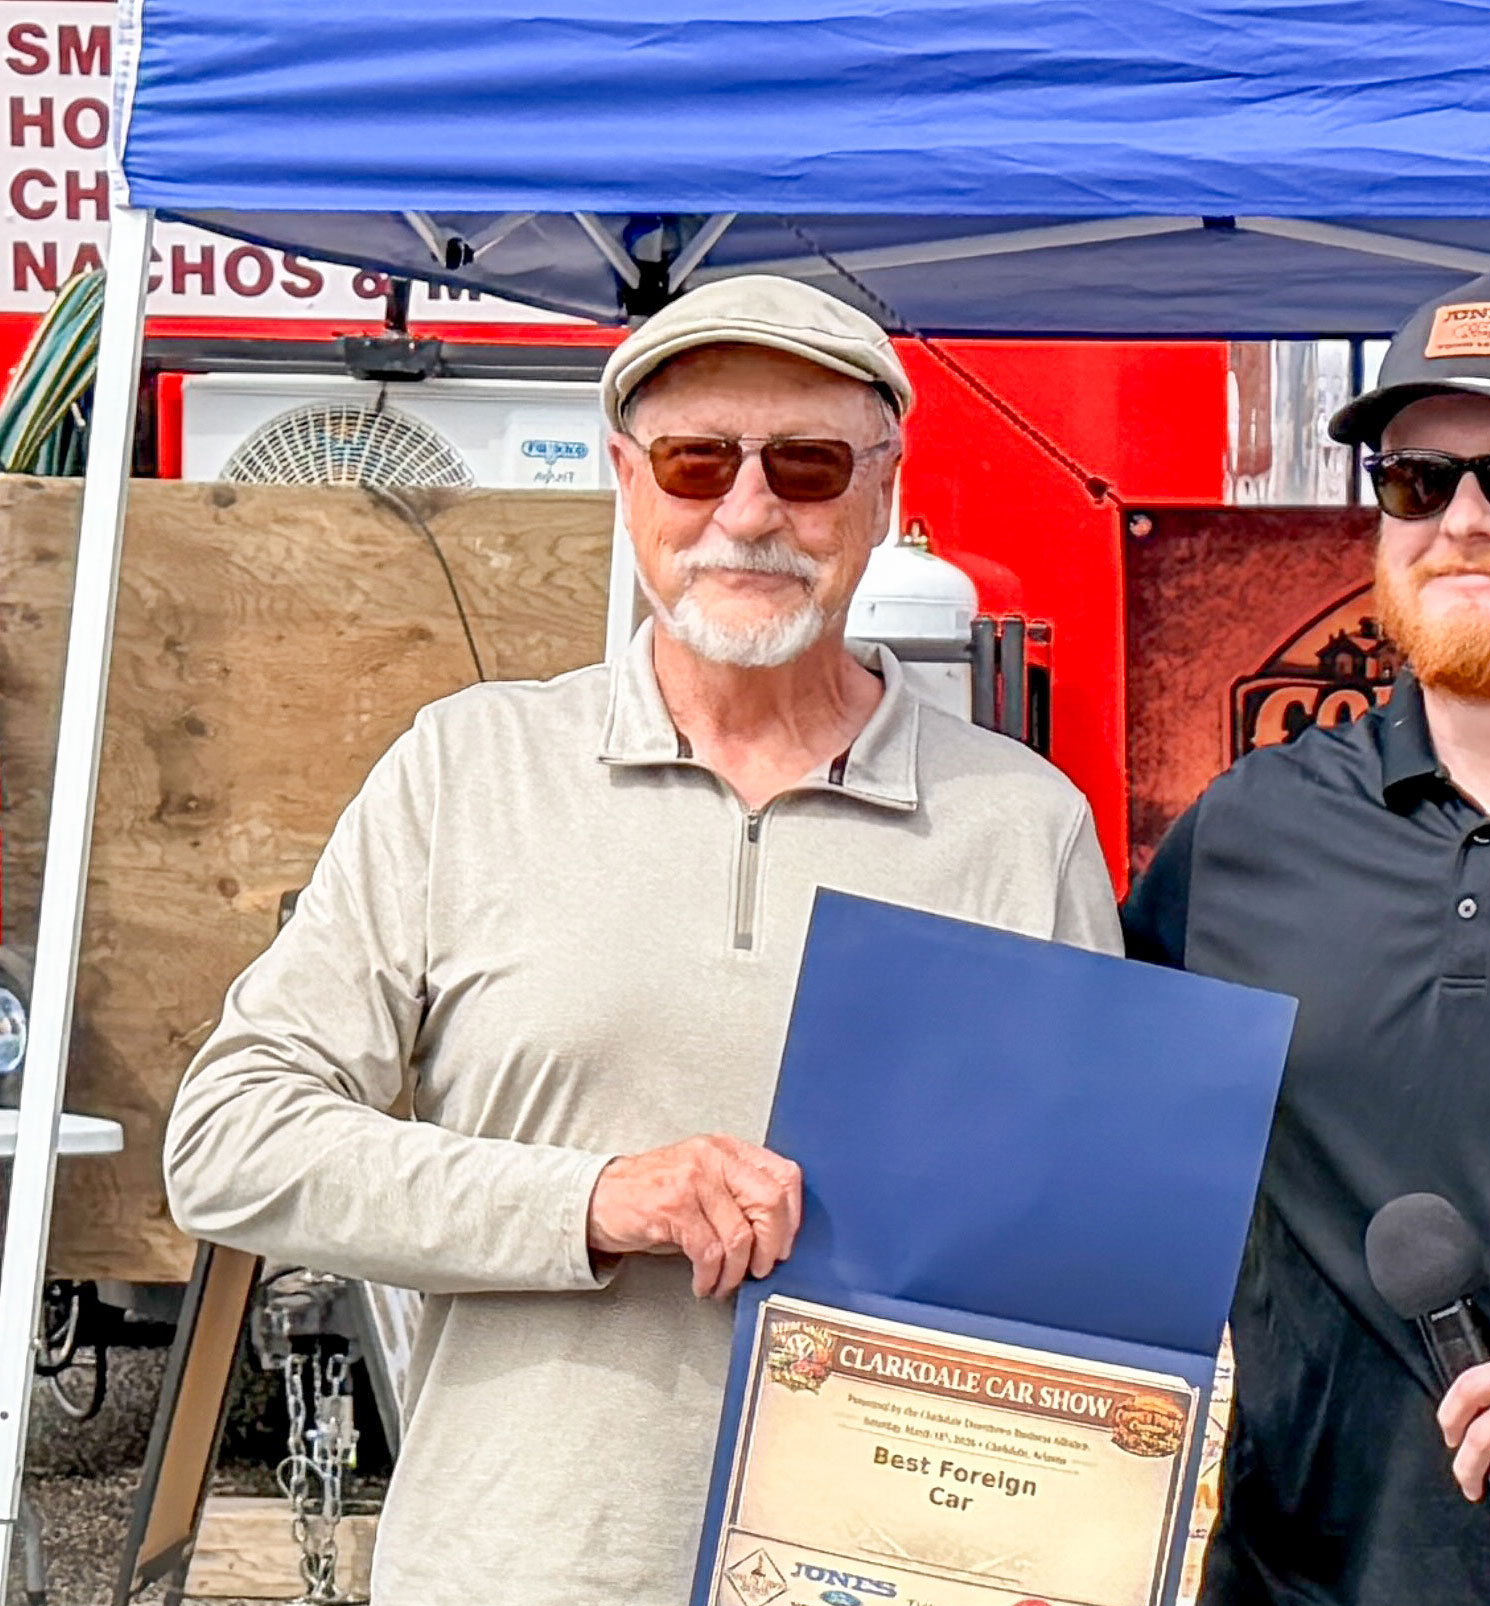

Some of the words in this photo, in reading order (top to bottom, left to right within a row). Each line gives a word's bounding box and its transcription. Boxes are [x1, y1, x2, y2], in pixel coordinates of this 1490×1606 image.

[839, 1345, 981, 1394] CLARKDALE
[985, 1376, 1034, 1405] CAR
[1039, 1387, 1112, 1418] SHOW
[874, 1446, 931, 1475] Best
[939, 1460, 1037, 1496] Foreign
[929, 1487, 974, 1511] Car
[791, 1562, 897, 1598] JONES
